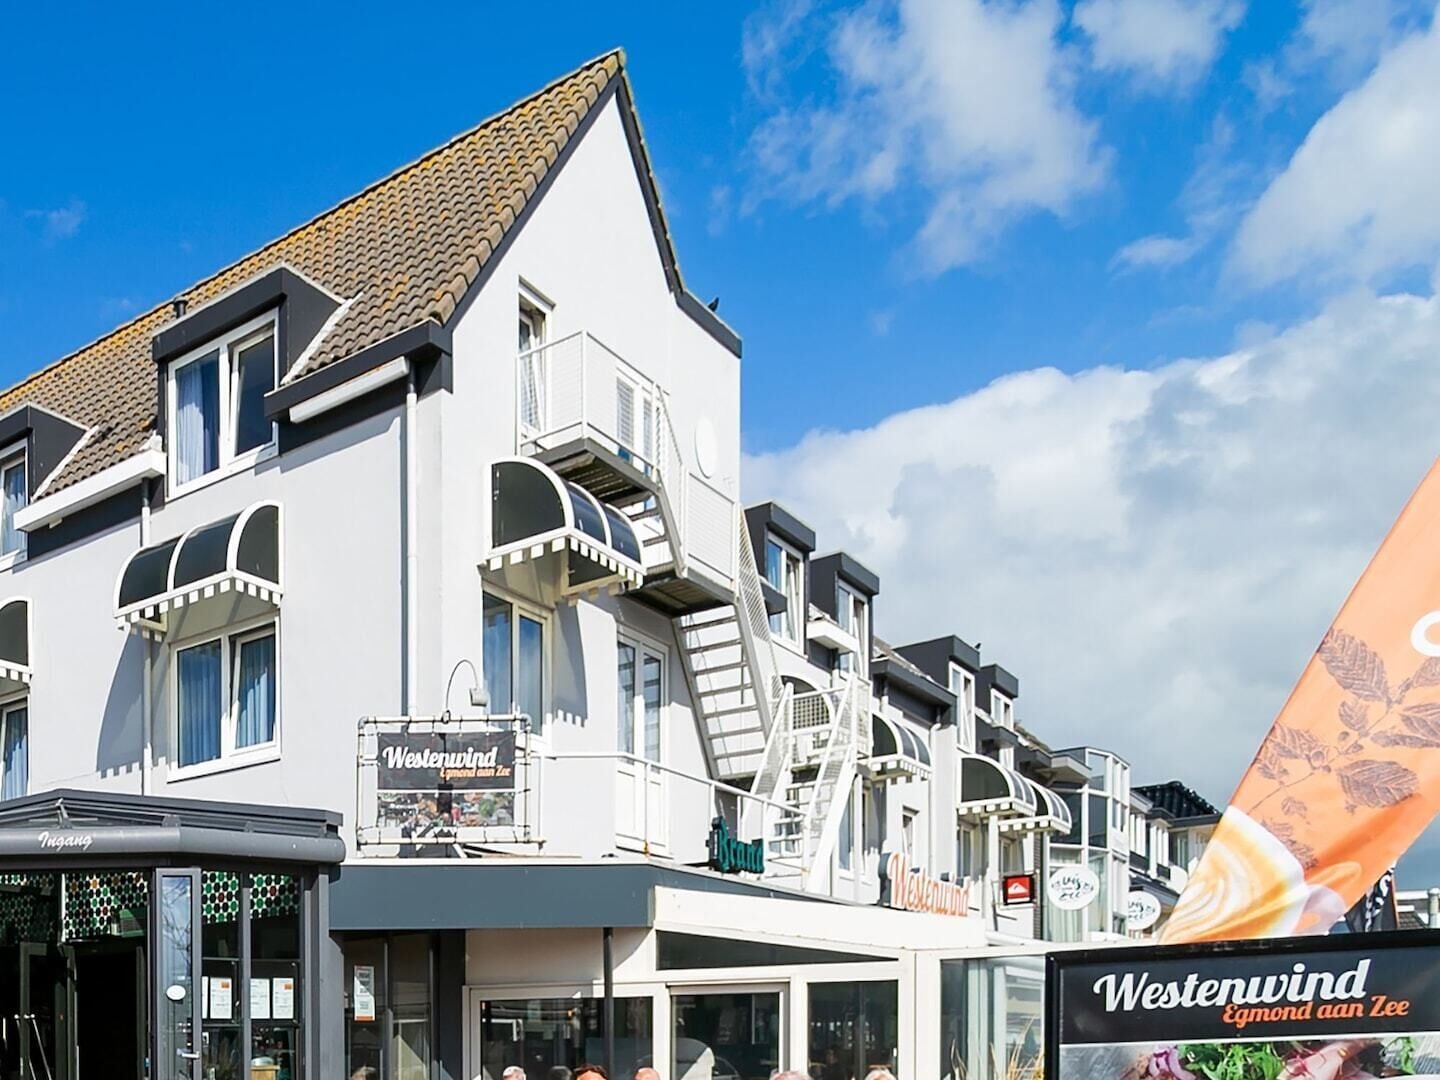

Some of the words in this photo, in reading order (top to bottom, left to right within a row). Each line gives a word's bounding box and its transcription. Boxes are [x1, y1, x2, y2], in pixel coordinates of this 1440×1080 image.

[382, 746, 498, 769] Westenwind
[495, 765, 511, 777] Zee
[38, 831, 93, 853] Ingang
[886, 850, 971, 918] Westenwind
[1093, 958, 1371, 1013] Westenwind
[1222, 1004, 1311, 1029] Egmond
[1315, 1003, 1363, 1019] aan
[1370, 995, 1409, 1018] Zee
